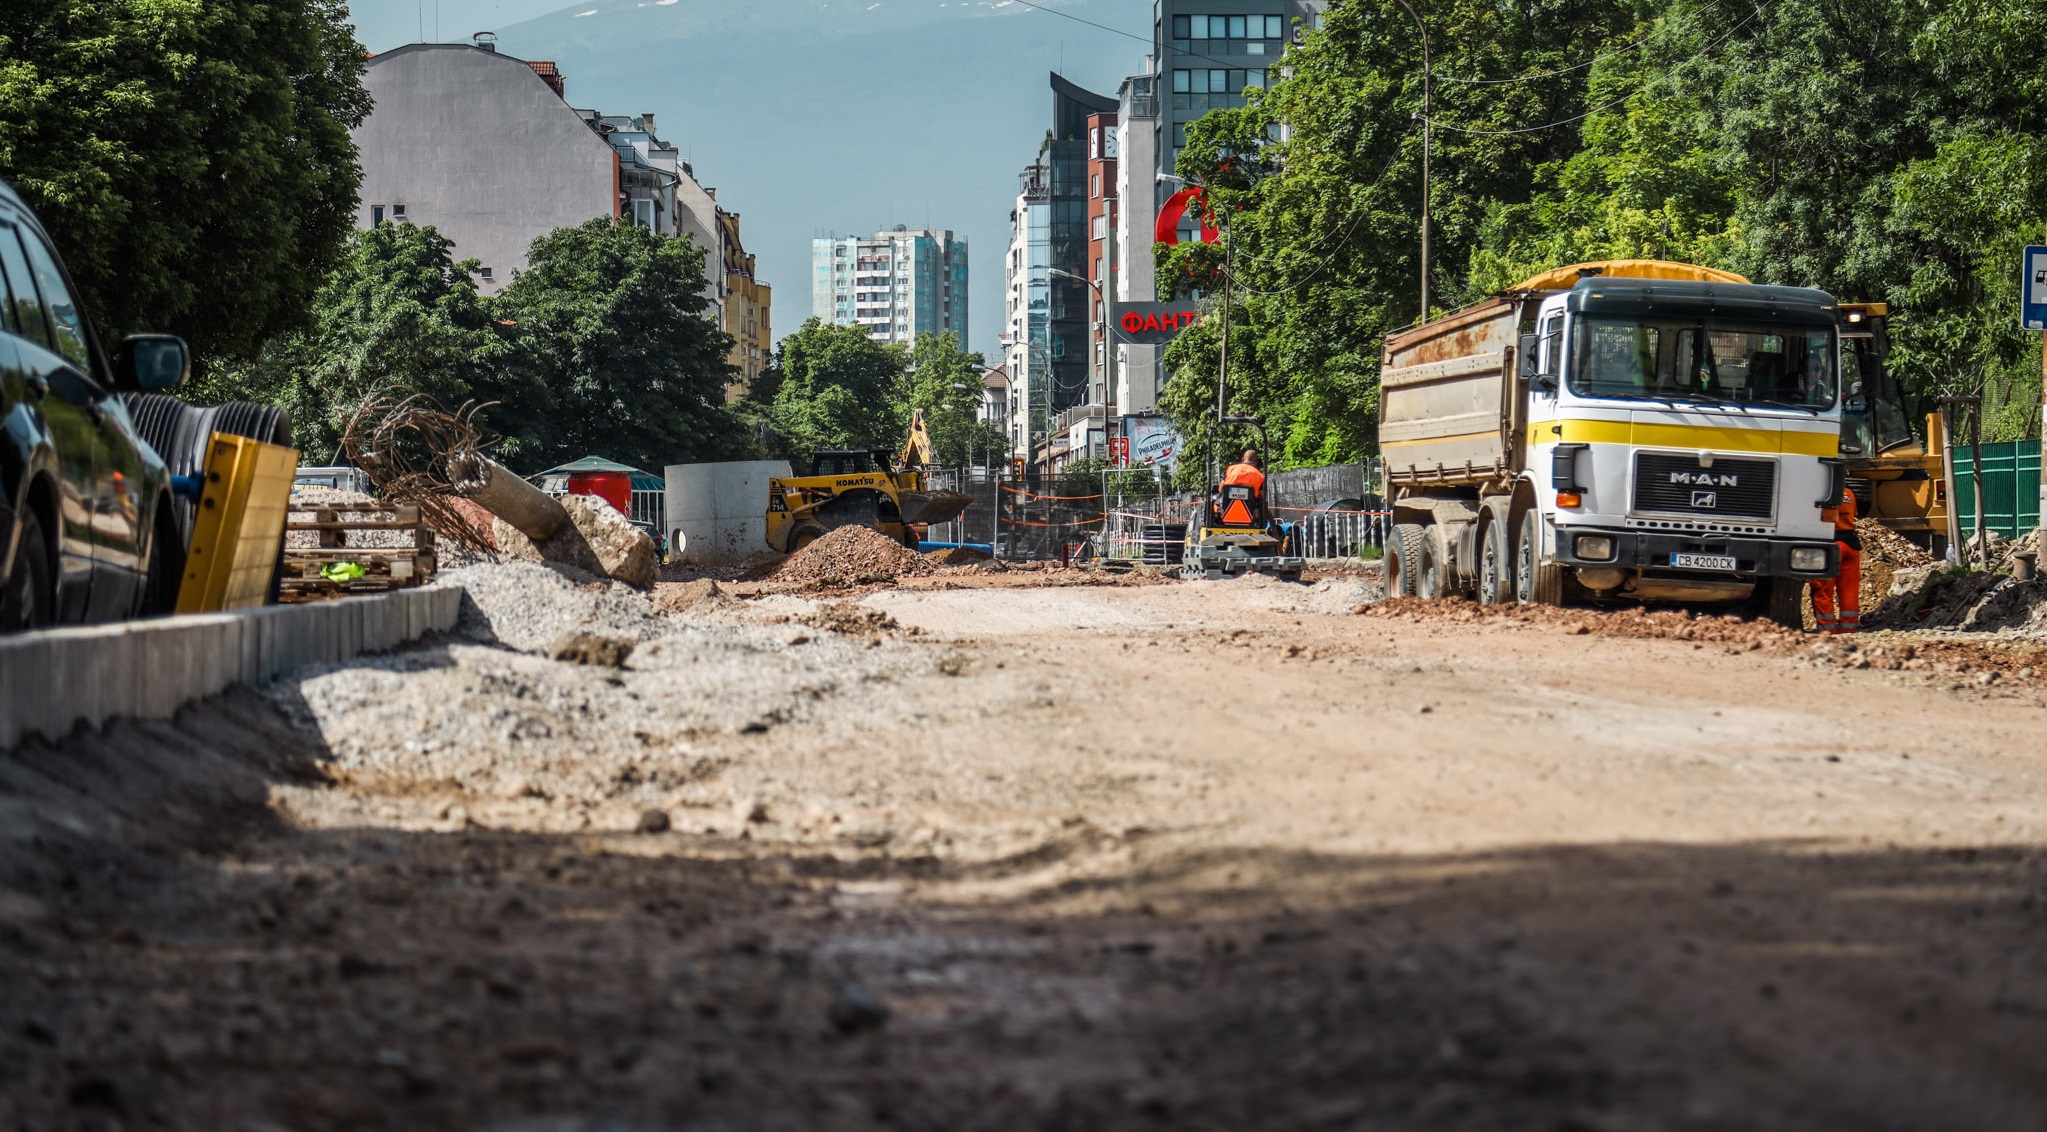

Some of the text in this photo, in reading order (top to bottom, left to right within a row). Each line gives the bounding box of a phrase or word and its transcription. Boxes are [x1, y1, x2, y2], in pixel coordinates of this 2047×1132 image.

[1121, 311, 1204, 334] ФАНТ
[836, 477, 874, 487] KOMATSU
[1678, 555, 1733, 569] CB 4200 CK
